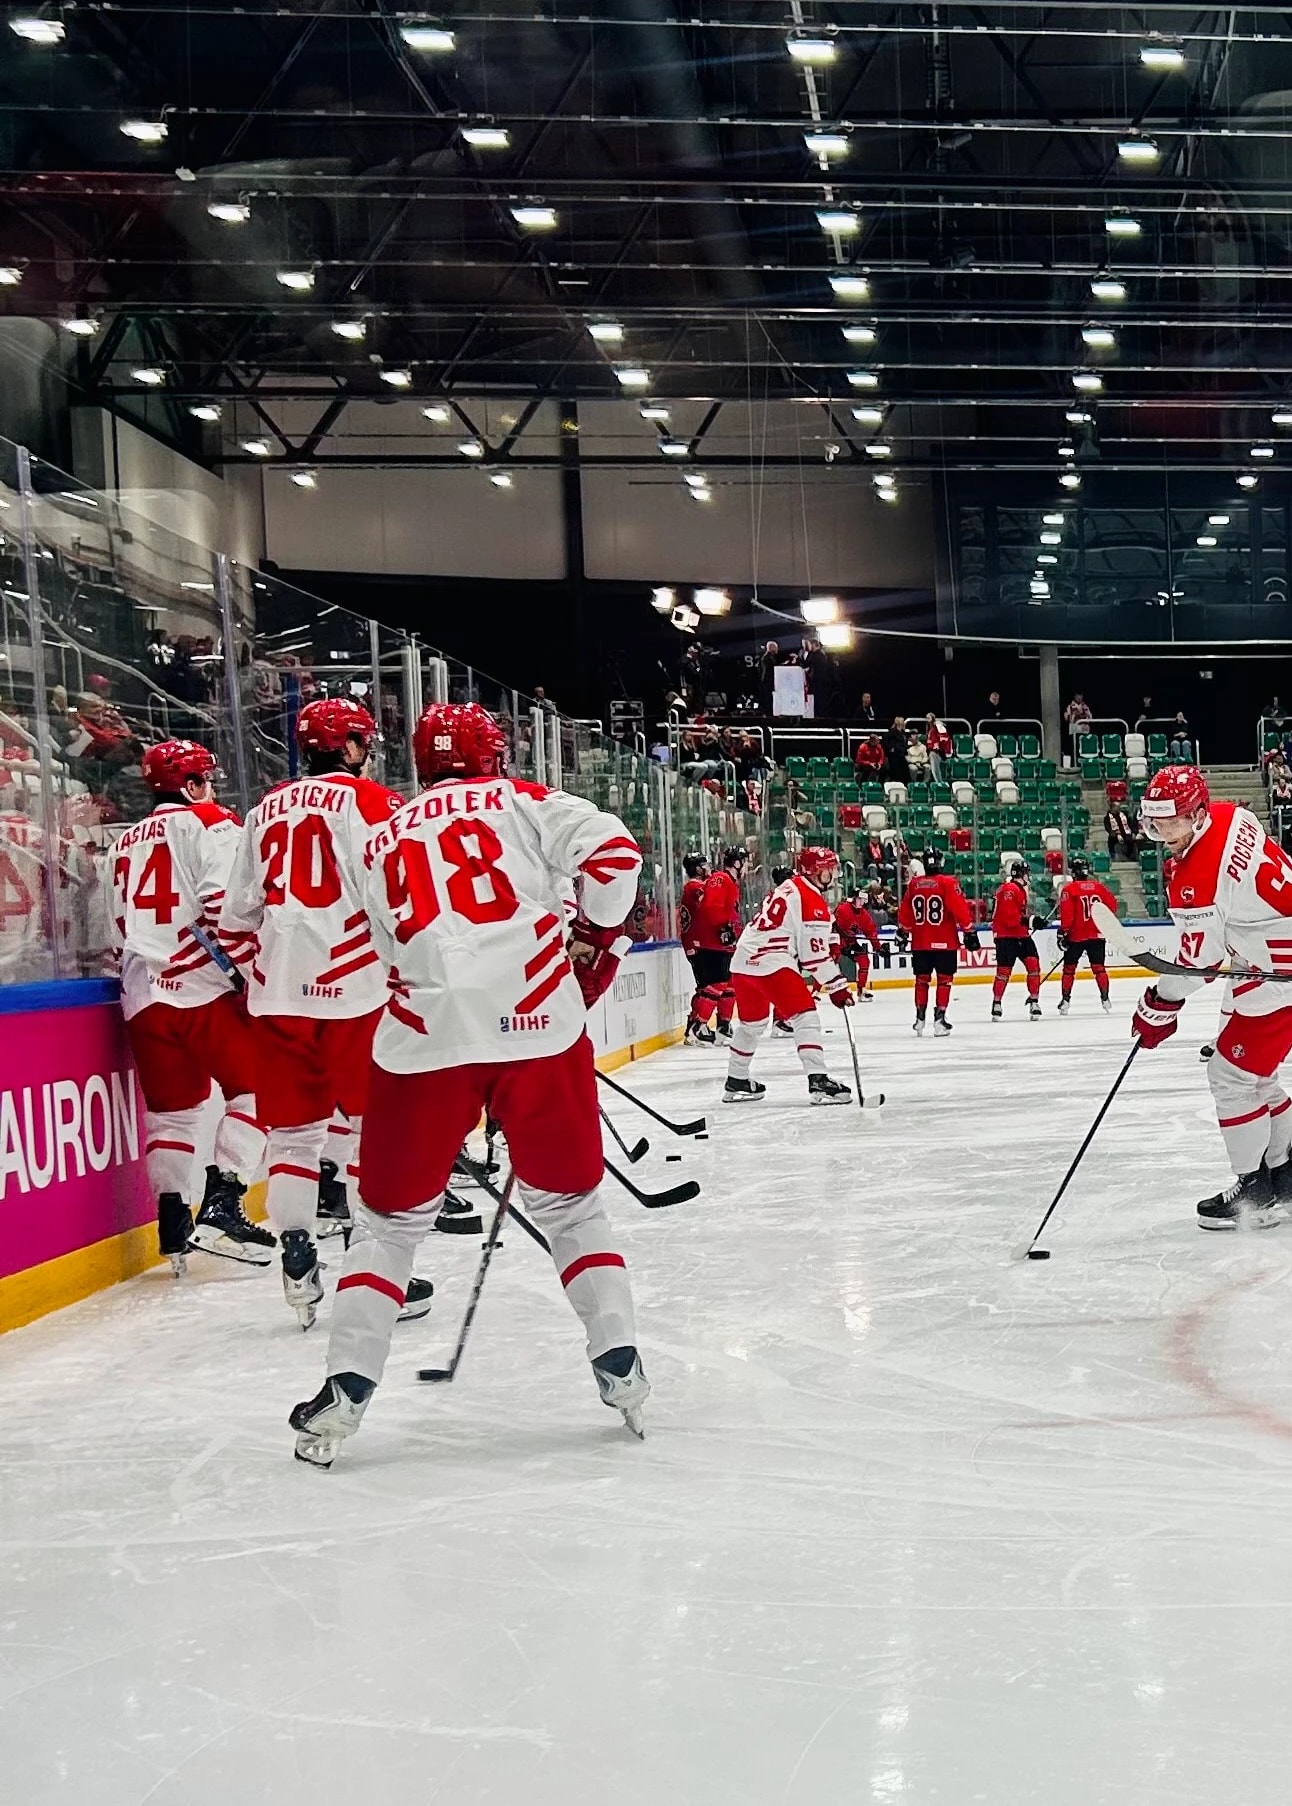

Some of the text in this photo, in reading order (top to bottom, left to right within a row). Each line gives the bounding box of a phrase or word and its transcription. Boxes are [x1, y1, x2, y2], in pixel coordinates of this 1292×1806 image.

[434, 735, 453, 751] 98
[260, 813, 342, 909] 20
[1226, 818, 1259, 884] POCIECH
[383, 817, 521, 945] 98
[956, 948, 998, 967] LIVE
[309, 984, 344, 998] IIHF
[1137, 1001, 1177, 1022] AUER
[511, 1014, 552, 1032] IIHF
[0, 1068, 140, 1201] AURON
